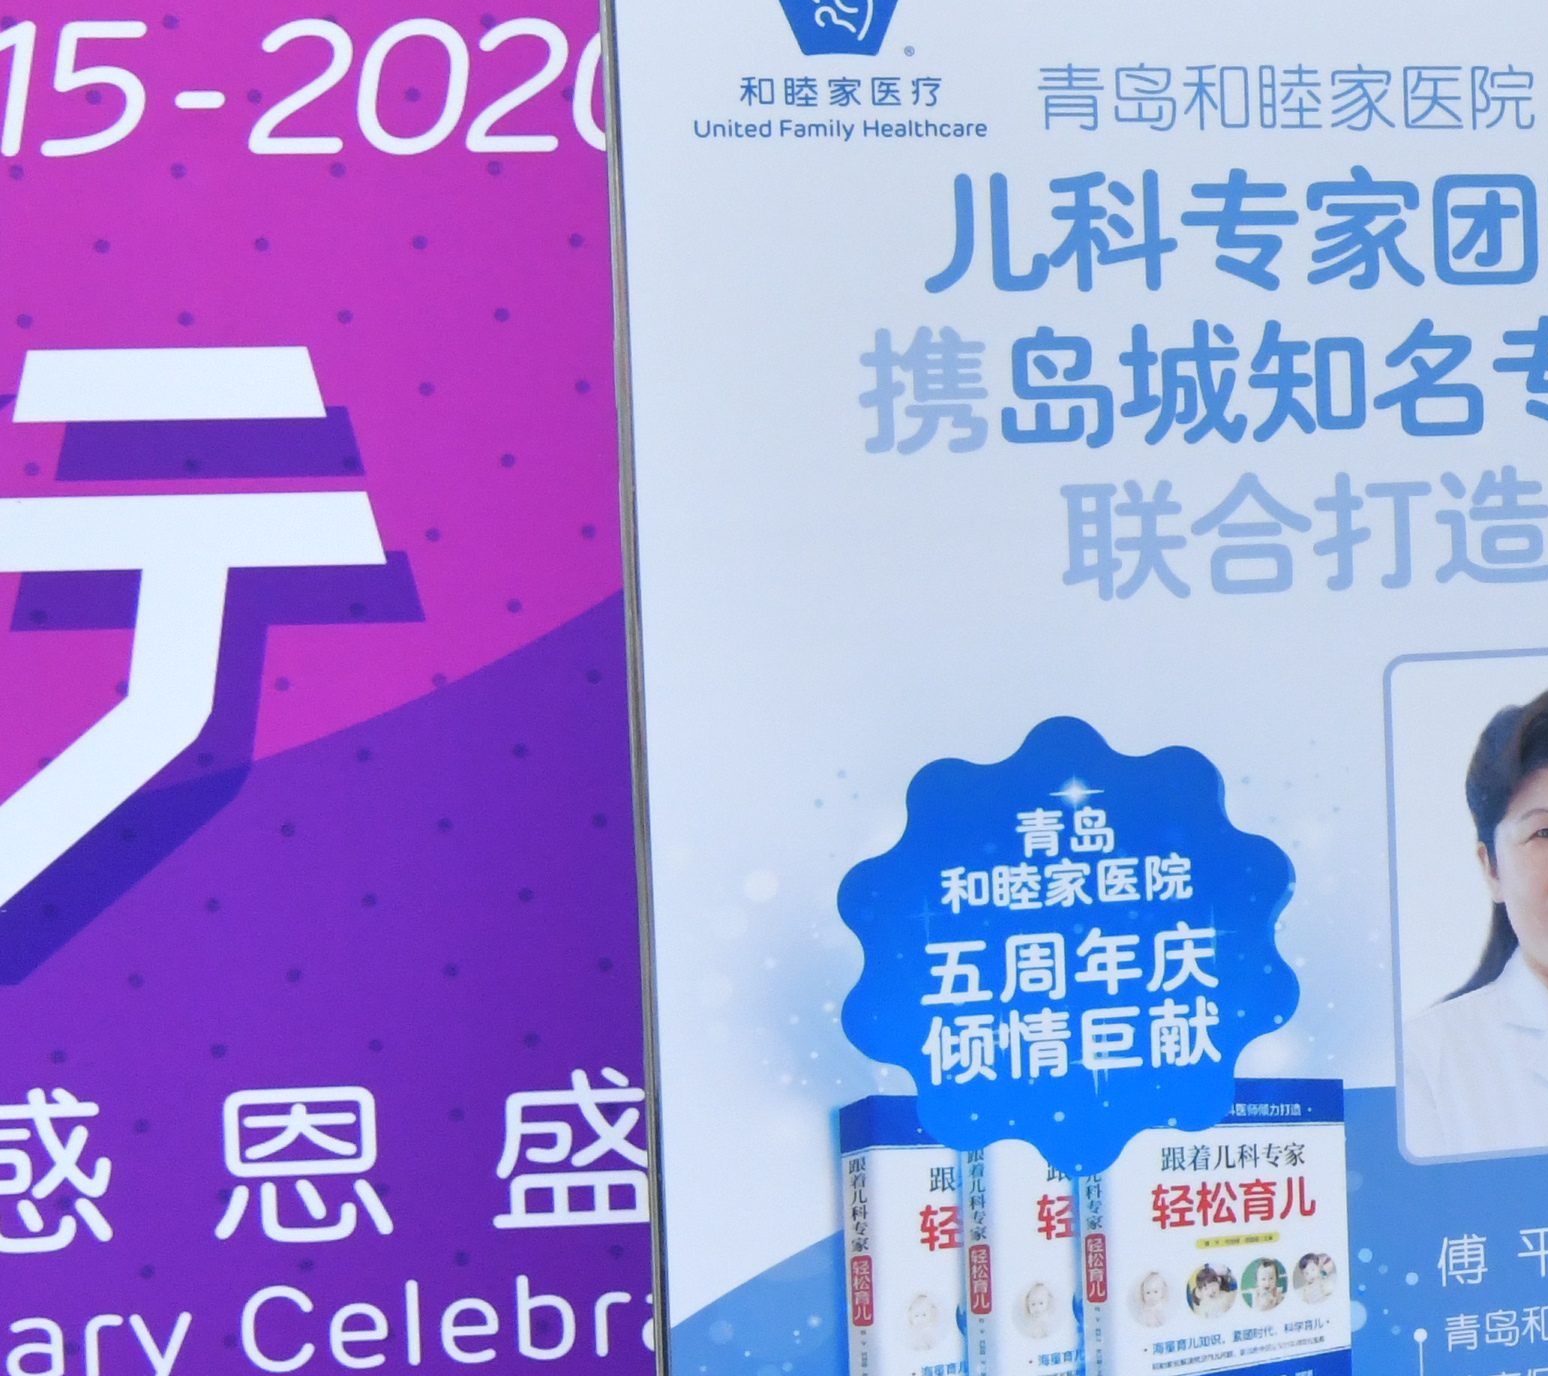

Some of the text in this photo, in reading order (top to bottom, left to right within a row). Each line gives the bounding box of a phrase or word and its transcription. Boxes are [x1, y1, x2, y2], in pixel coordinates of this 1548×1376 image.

[739, 76, 943, 108] 和睦家医疗
[1036, 62, 1537, 132] 青岛和睦家医院
[693, 118, 988, 142] United Family Healthcare
[1015, 805, 1116, 858] 青岛
[940, 852, 1194, 914] 和睦家医院
[920, 920, 1220, 1006] 五周年庆
[920, 995, 1223, 1086] 倾情巨献
[1160, 1141, 1306, 1172] 跟着儿科专家
[1151, 1175, 1317, 1230] 轻松育儿
